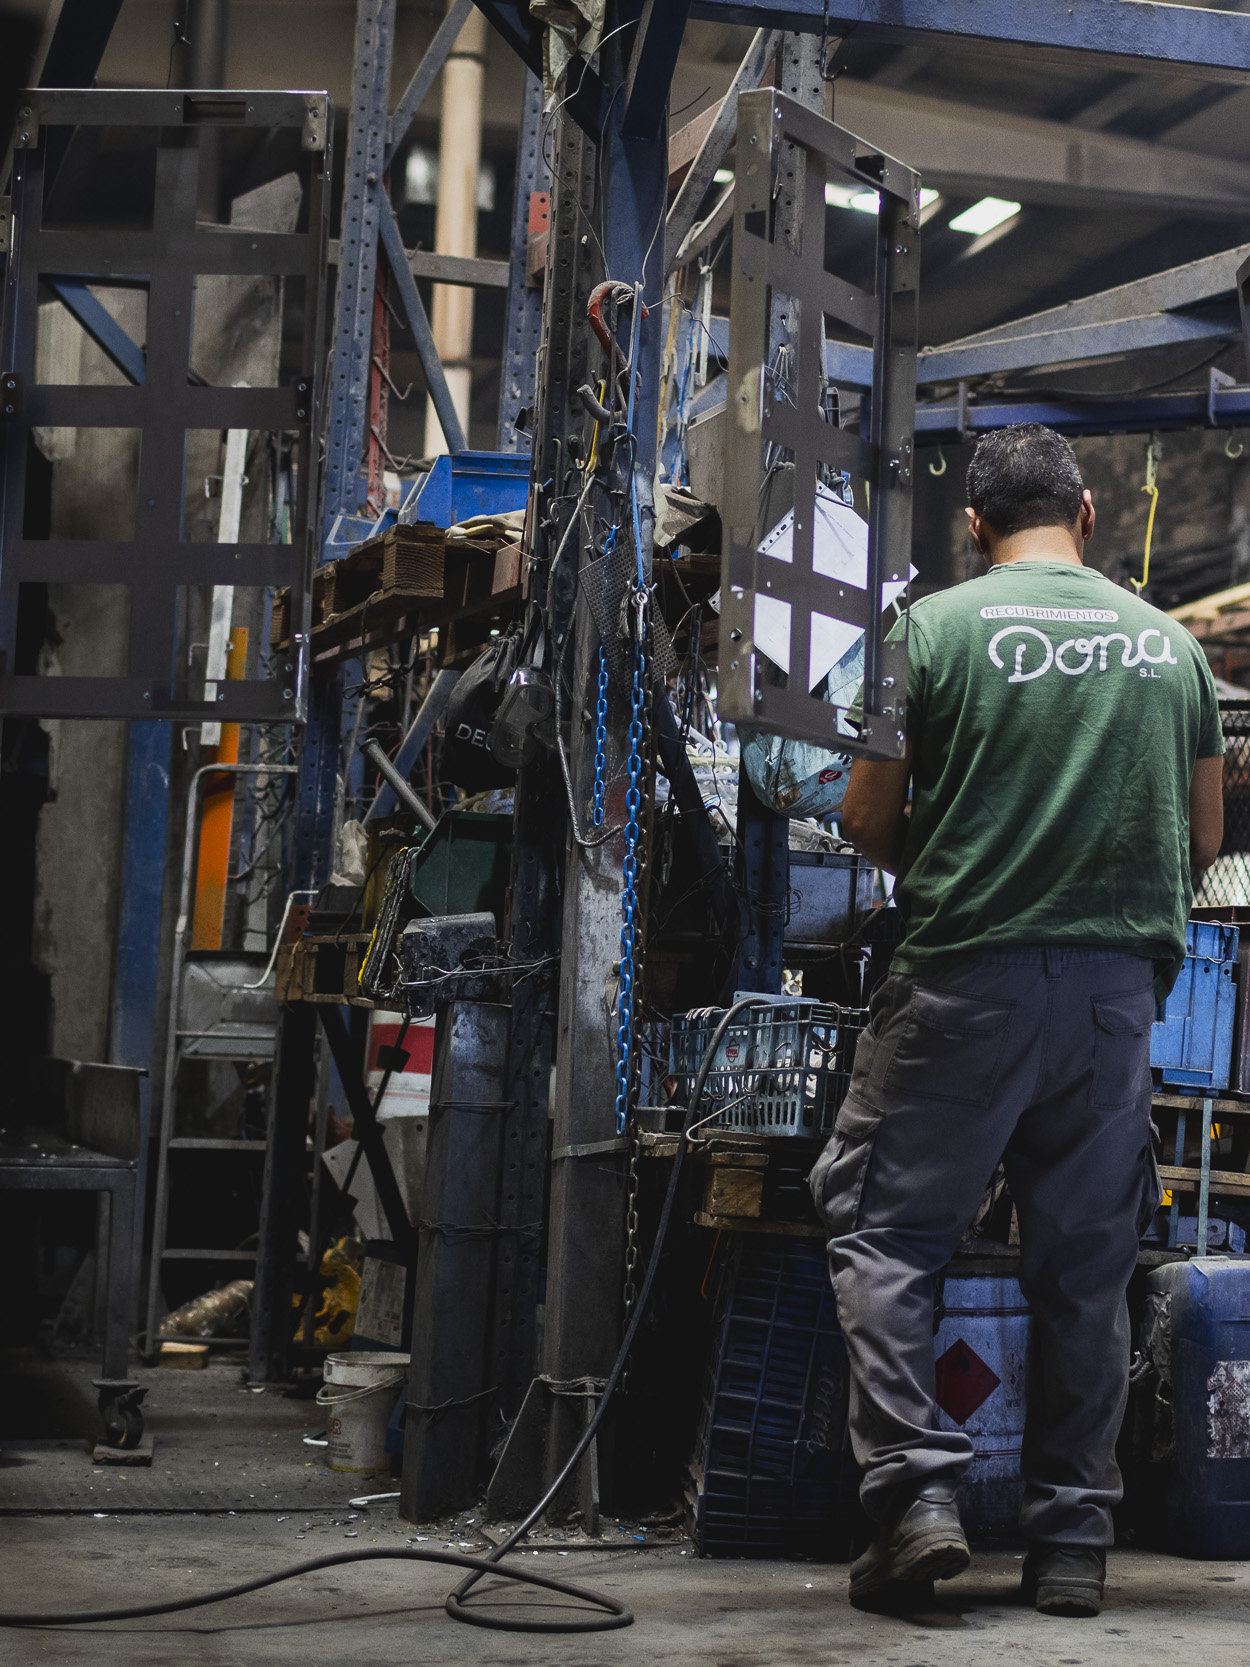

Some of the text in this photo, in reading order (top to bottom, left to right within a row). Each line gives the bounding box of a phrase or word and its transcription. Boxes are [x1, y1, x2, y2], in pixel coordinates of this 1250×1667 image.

[984, 606, 1115, 621] RECUBRIMIENTOS
[987, 624, 1178, 683] Dona
[1138, 667, 1161, 679] S.L.
